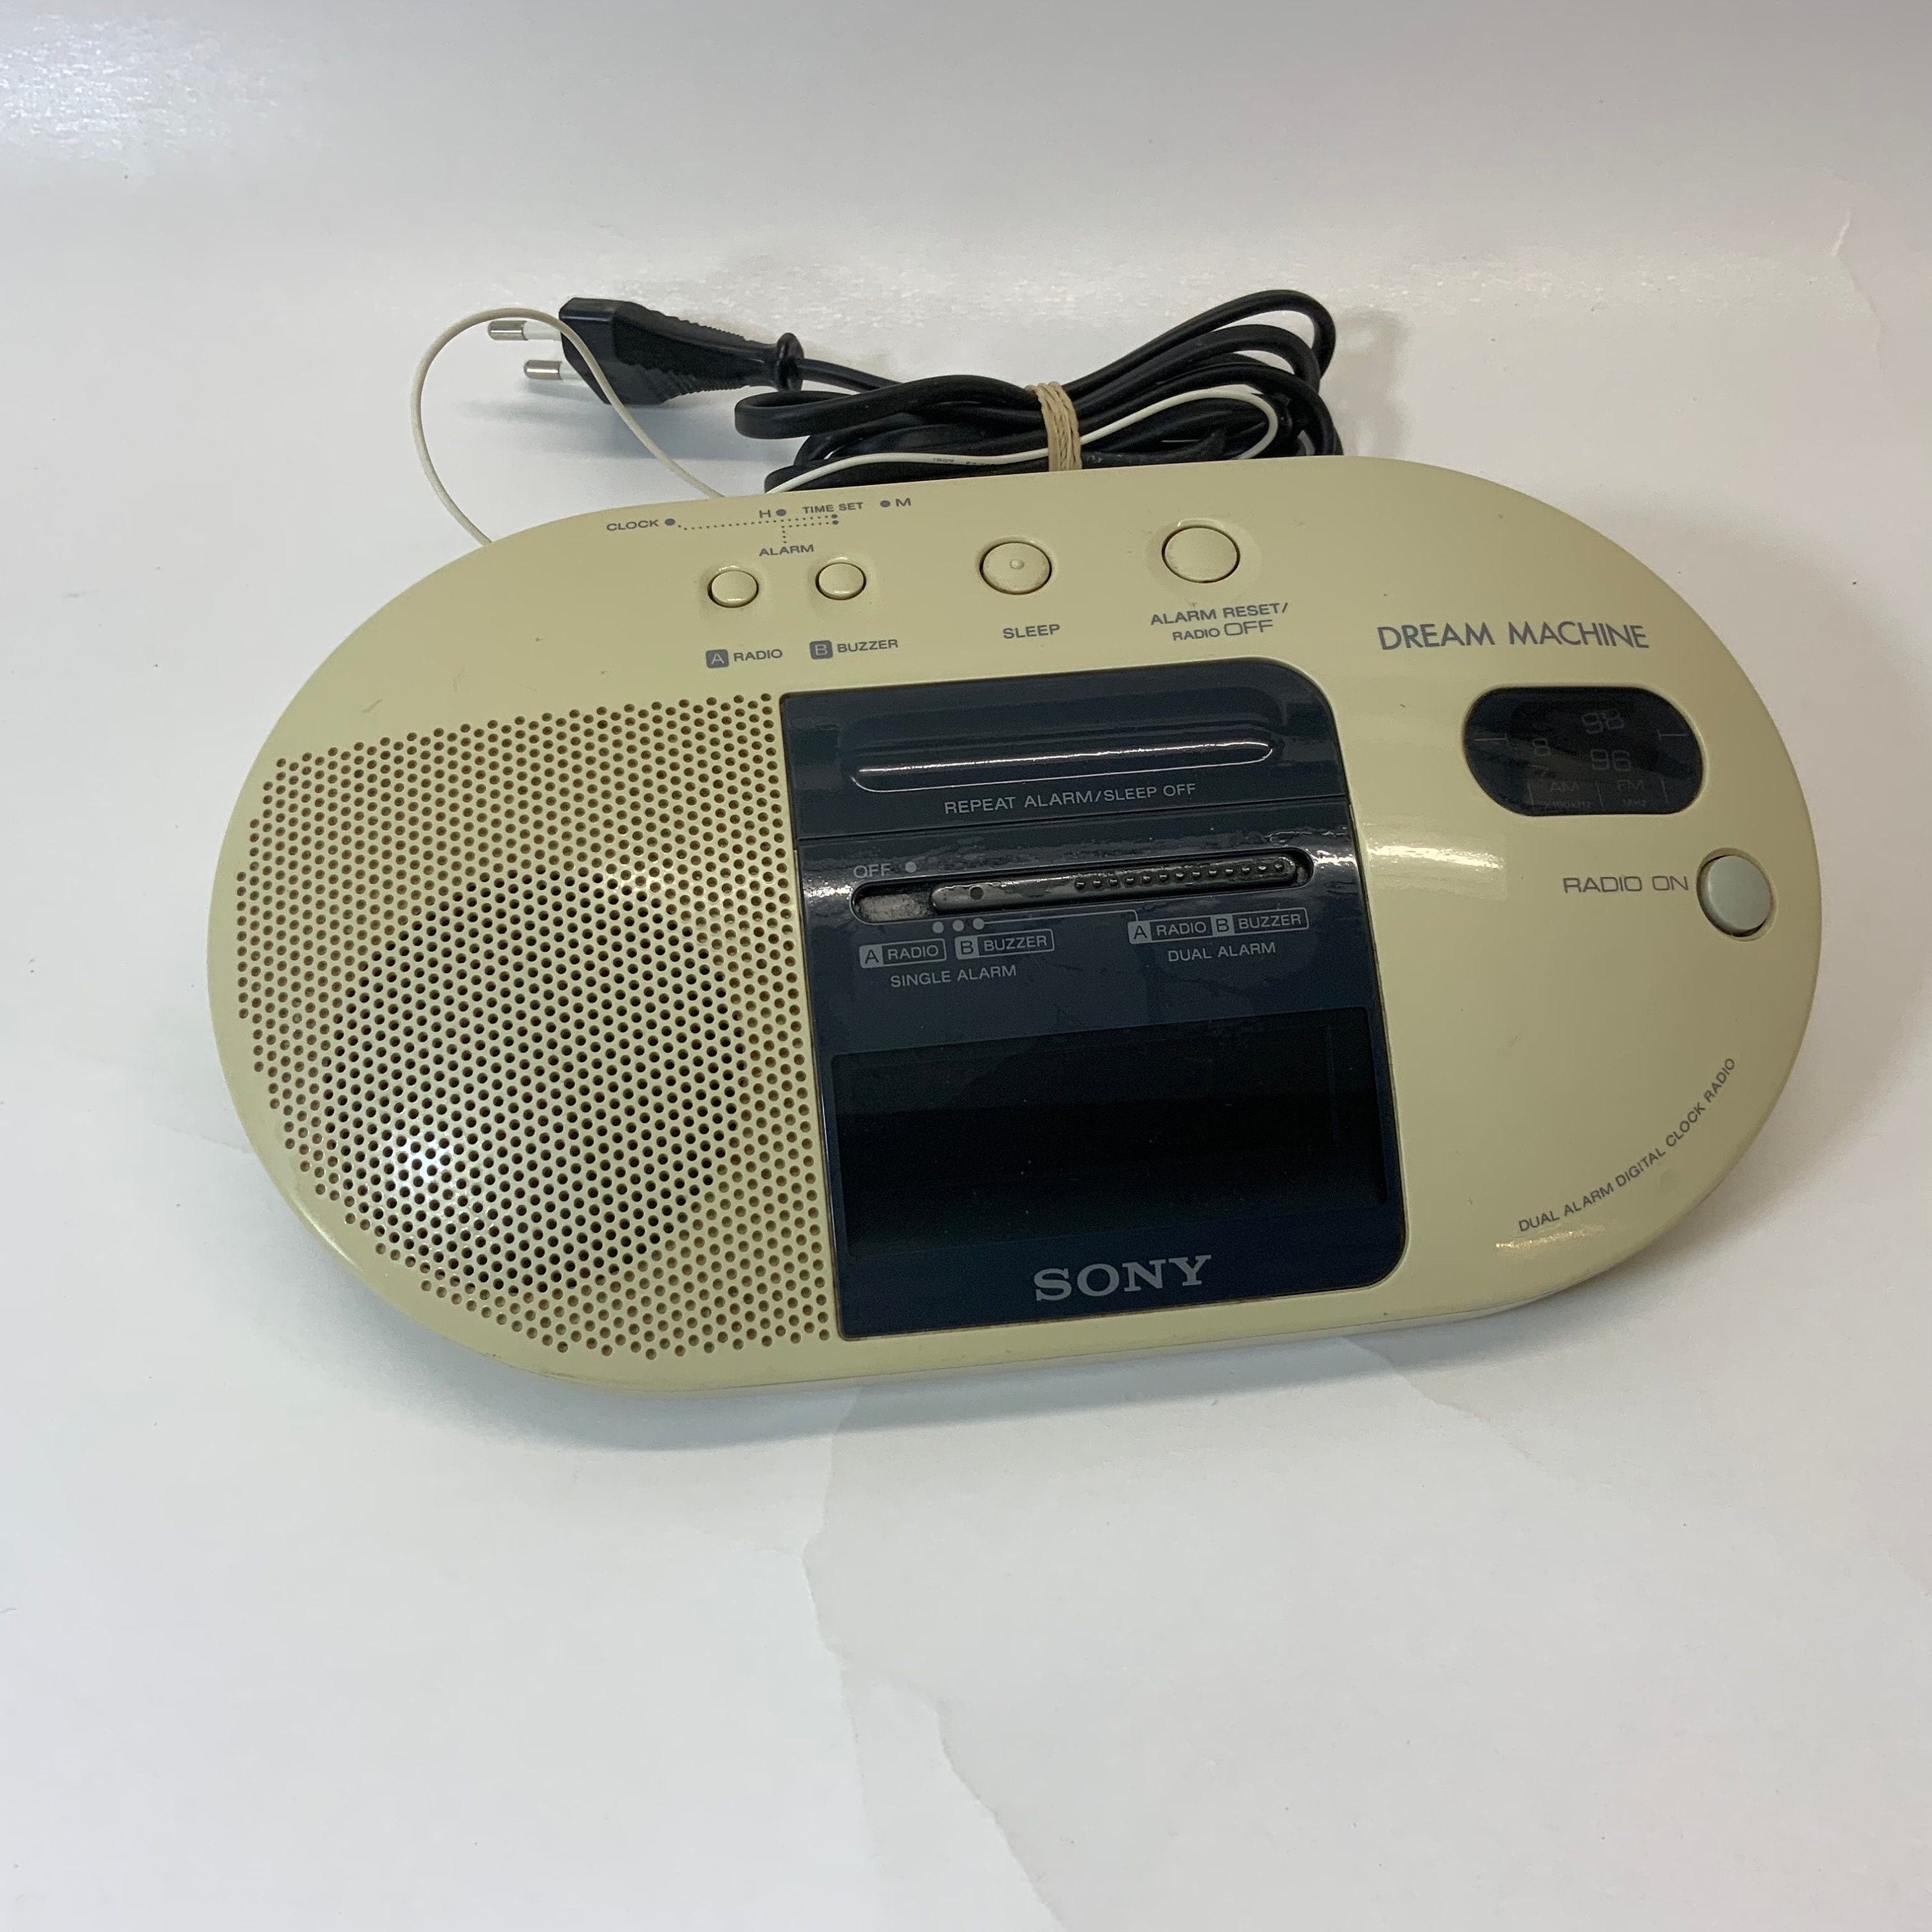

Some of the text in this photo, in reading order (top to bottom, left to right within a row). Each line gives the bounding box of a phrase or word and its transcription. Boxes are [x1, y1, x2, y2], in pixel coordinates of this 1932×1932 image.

[802, 502, 864, 514] TIME SET
[895, 498, 911, 507] M
[759, 510, 772, 518] H
[607, 519, 659, 531] CLOCK
[759, 544, 814, 557] ALARM
[1151, 602, 1288, 625] ALARM RESET/
[1003, 623, 1060, 639] SLEEP
[1172, 620, 1273, 641] RADIO OFF
[1378, 621, 1649, 650] DREAM MACHINE
[710, 649, 782, 667] A RADIO
[813, 639, 898, 658] B BUZZER
[1590, 748, 1632, 772] 96
[1549, 780, 1645, 793] AM FM
[944, 797, 1016, 815] REPEAT
[1163, 784, 1196, 797] OFF
[853, 864, 891, 877] OFF
[1563, 875, 1689, 893] RADIO ON
[1132, 913, 1302, 940] A RADIO B BUZZER
[864, 935, 1047, 965] A RADIO B BUZZER
[1168, 942, 1276, 962] DUAL ALARM
[890, 965, 1017, 988] SINGLE ALARM
[1519, 1058, 1735, 1231] DUAL ALARM DIGITAL CLOCK RADIO
[1034, 1255, 1212, 1302] SONY
